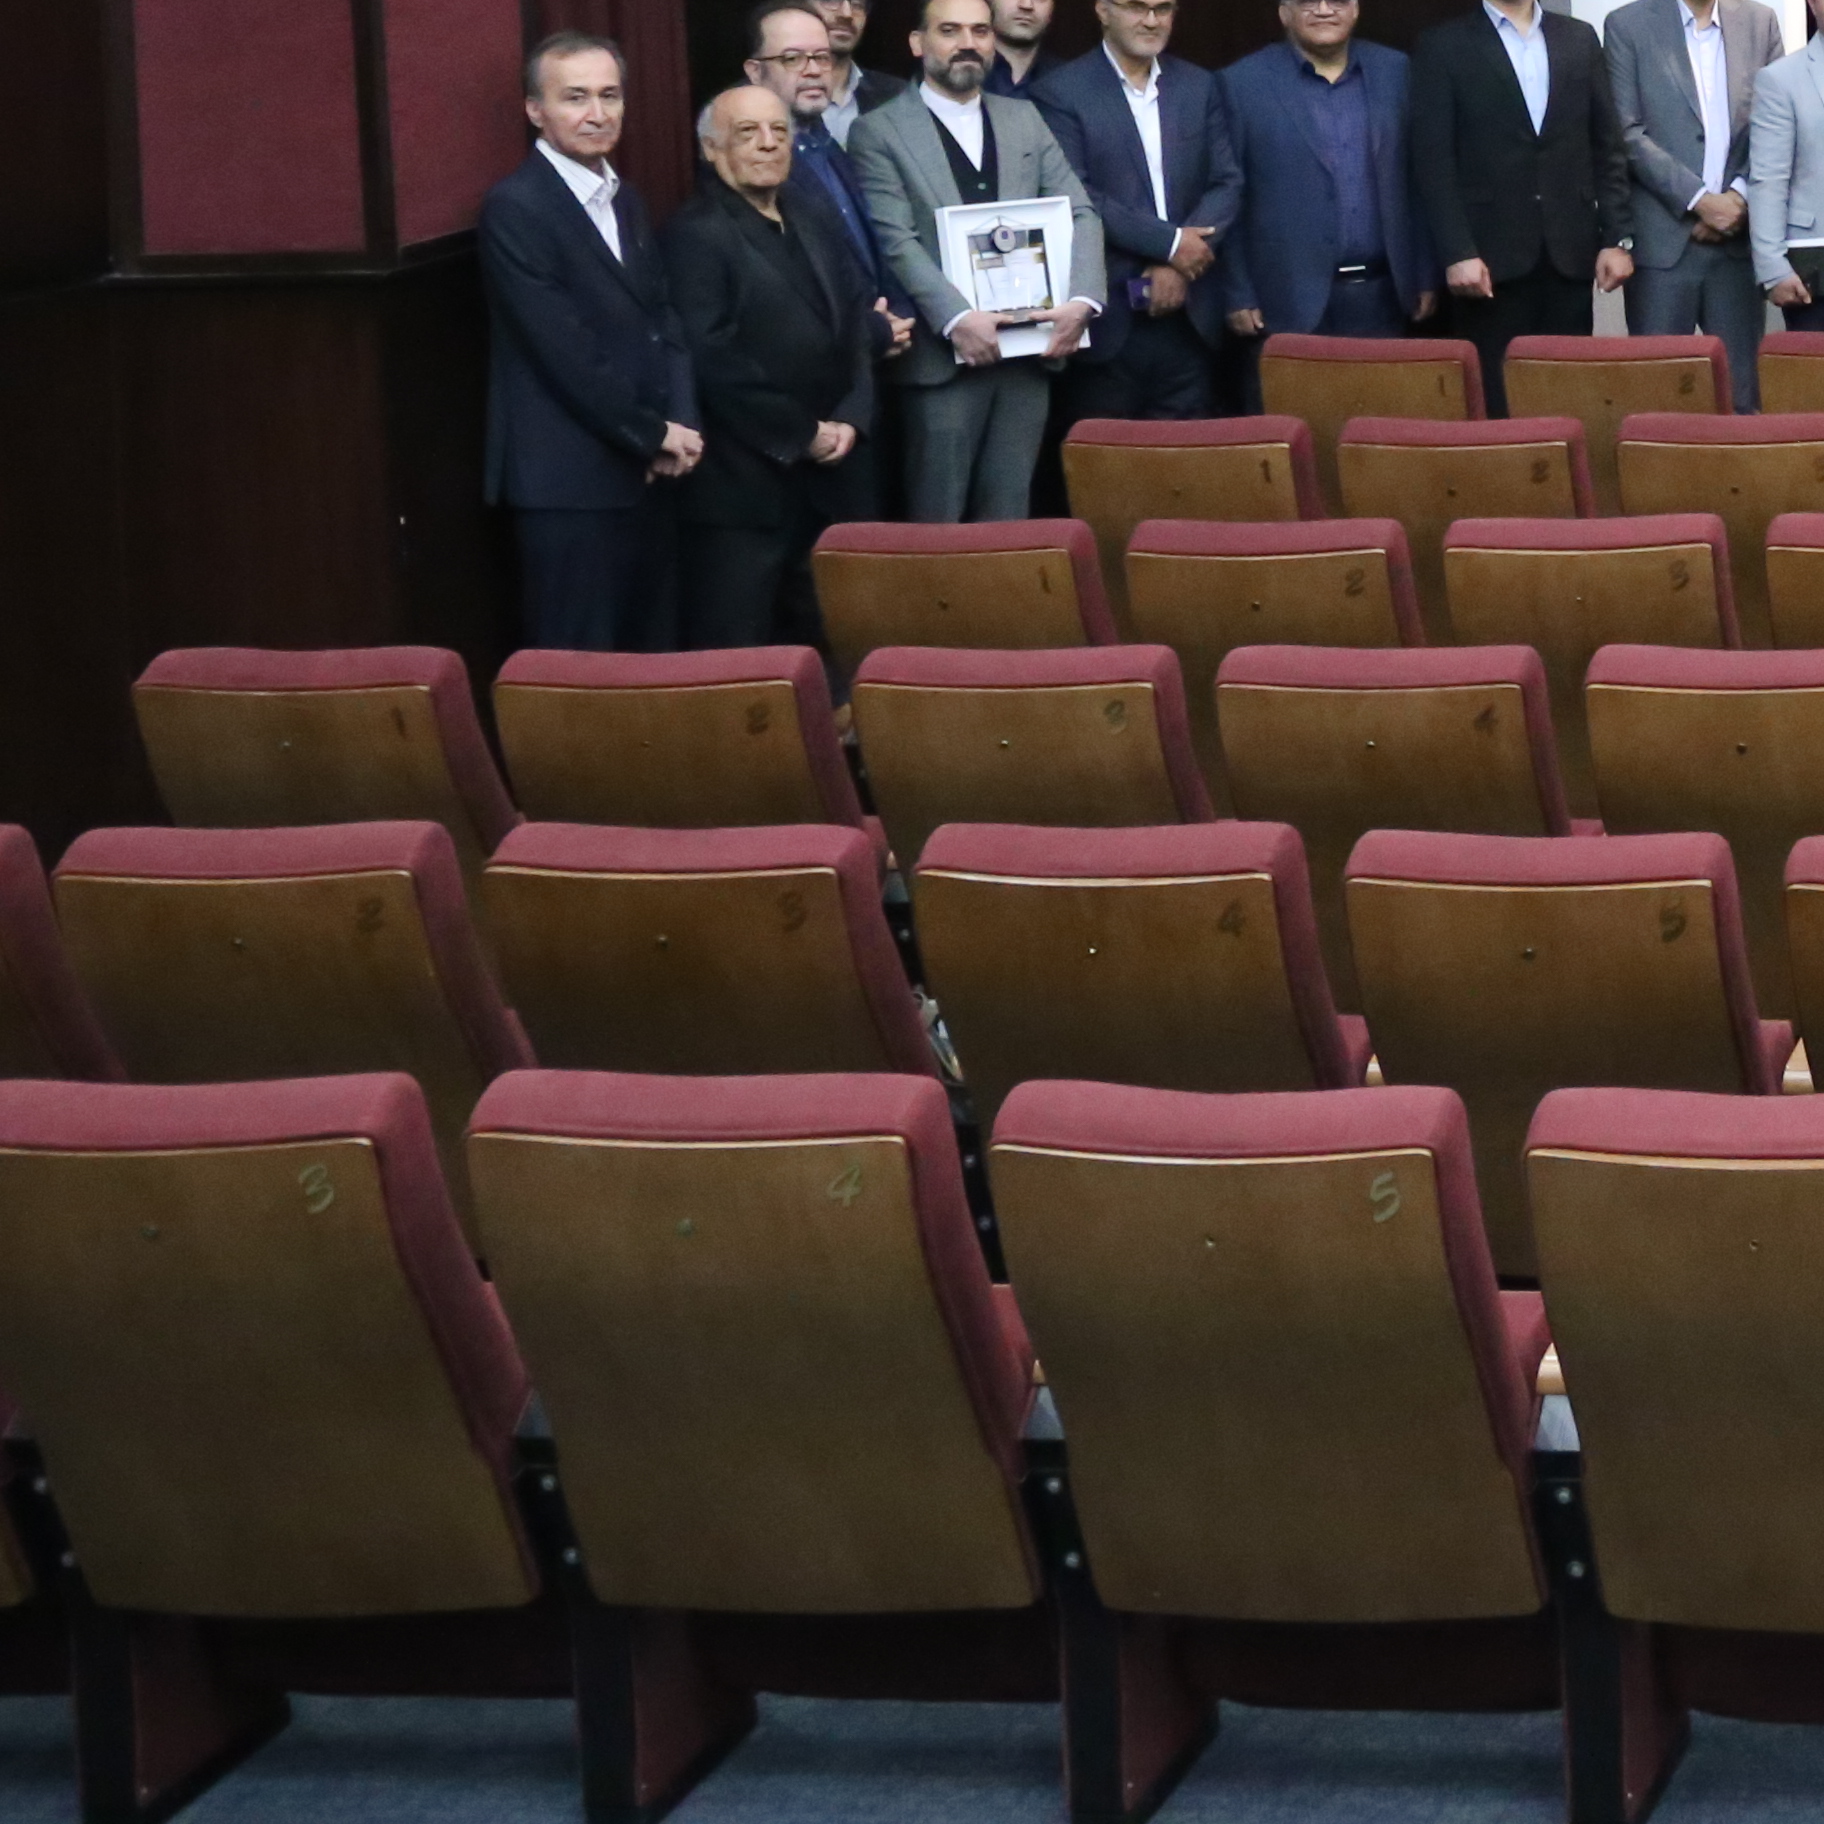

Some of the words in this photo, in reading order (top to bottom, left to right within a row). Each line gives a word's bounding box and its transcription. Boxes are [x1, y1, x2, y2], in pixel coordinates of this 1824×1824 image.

[1260, 459, 1273, 484] 1
[1038, 564, 1052, 595] 1
[1344, 568, 1366, 597] 2
[297, 1162, 335, 1214] 3
[827, 1160, 864, 1208] 4
[1369, 1170, 1402, 1224] 5
